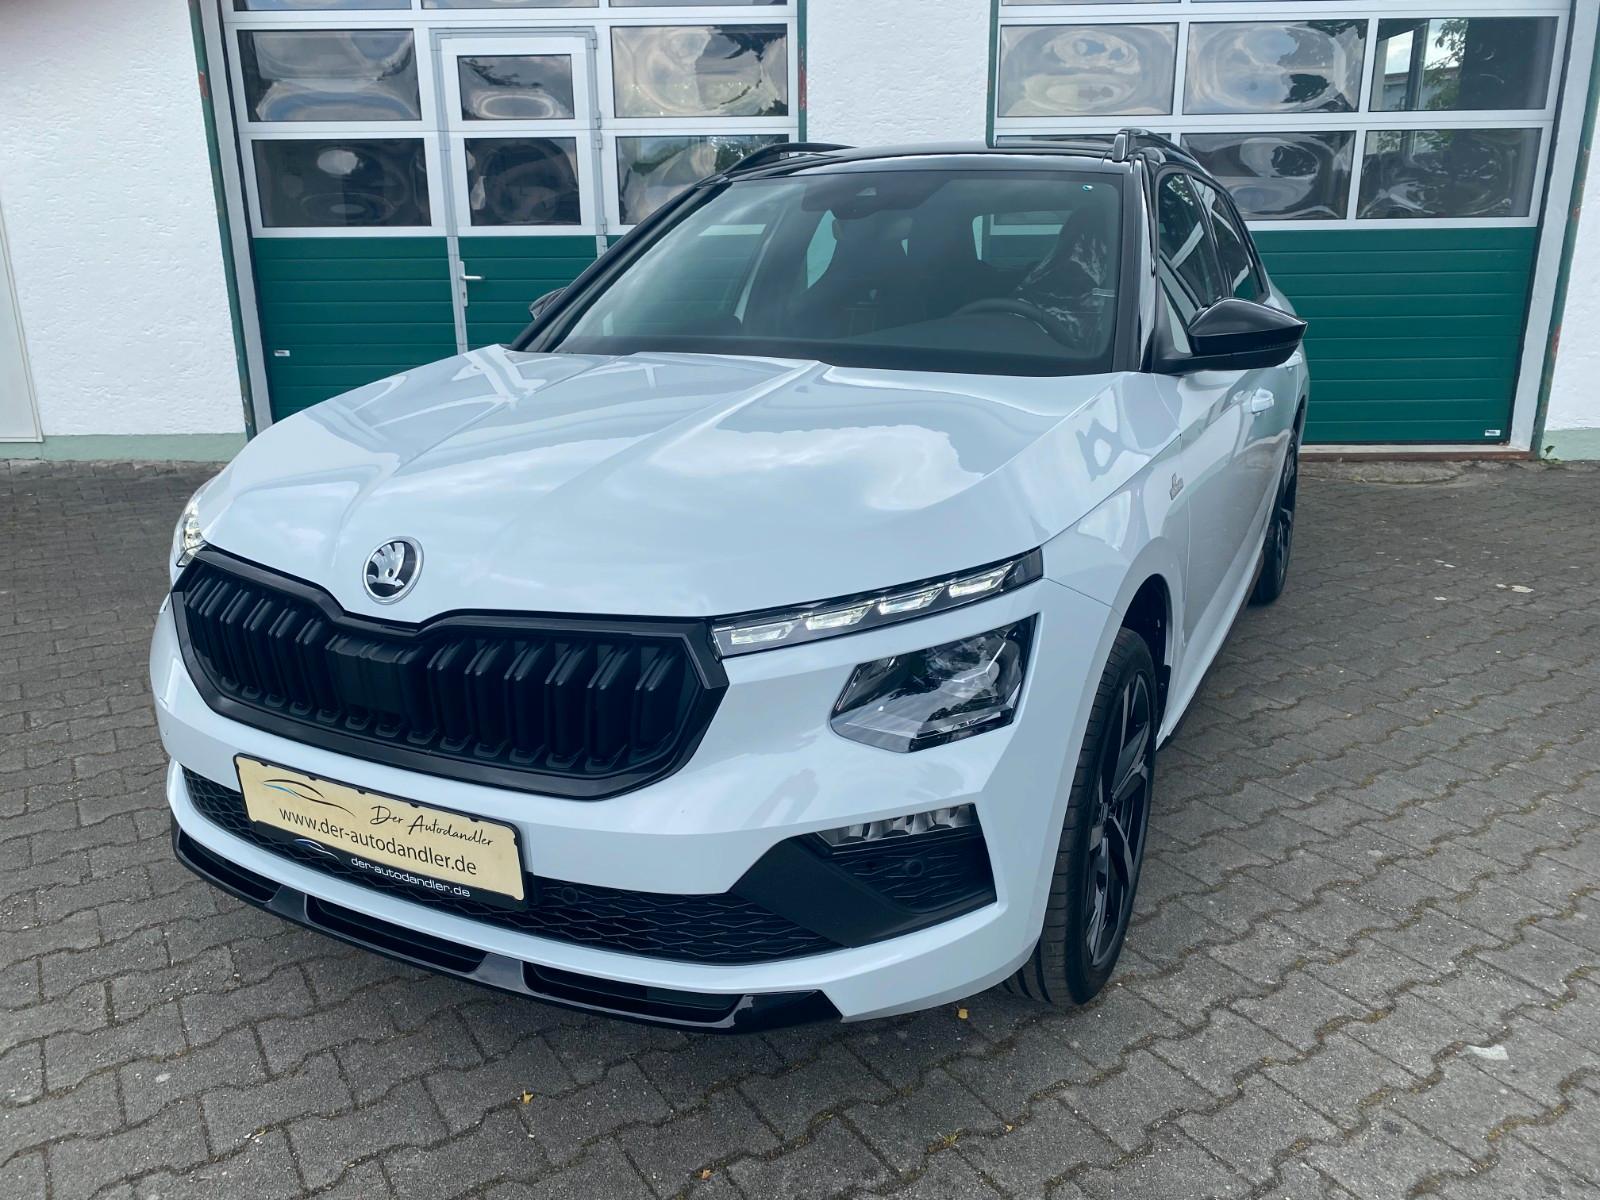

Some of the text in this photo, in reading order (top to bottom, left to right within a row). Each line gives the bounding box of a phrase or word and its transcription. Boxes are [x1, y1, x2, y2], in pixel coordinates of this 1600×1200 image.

[279, 807, 477, 875] www.der-autodandler.de
[371, 805, 494, 846] Der Autodandler
[351, 857, 471, 897] der-autodandler.de
